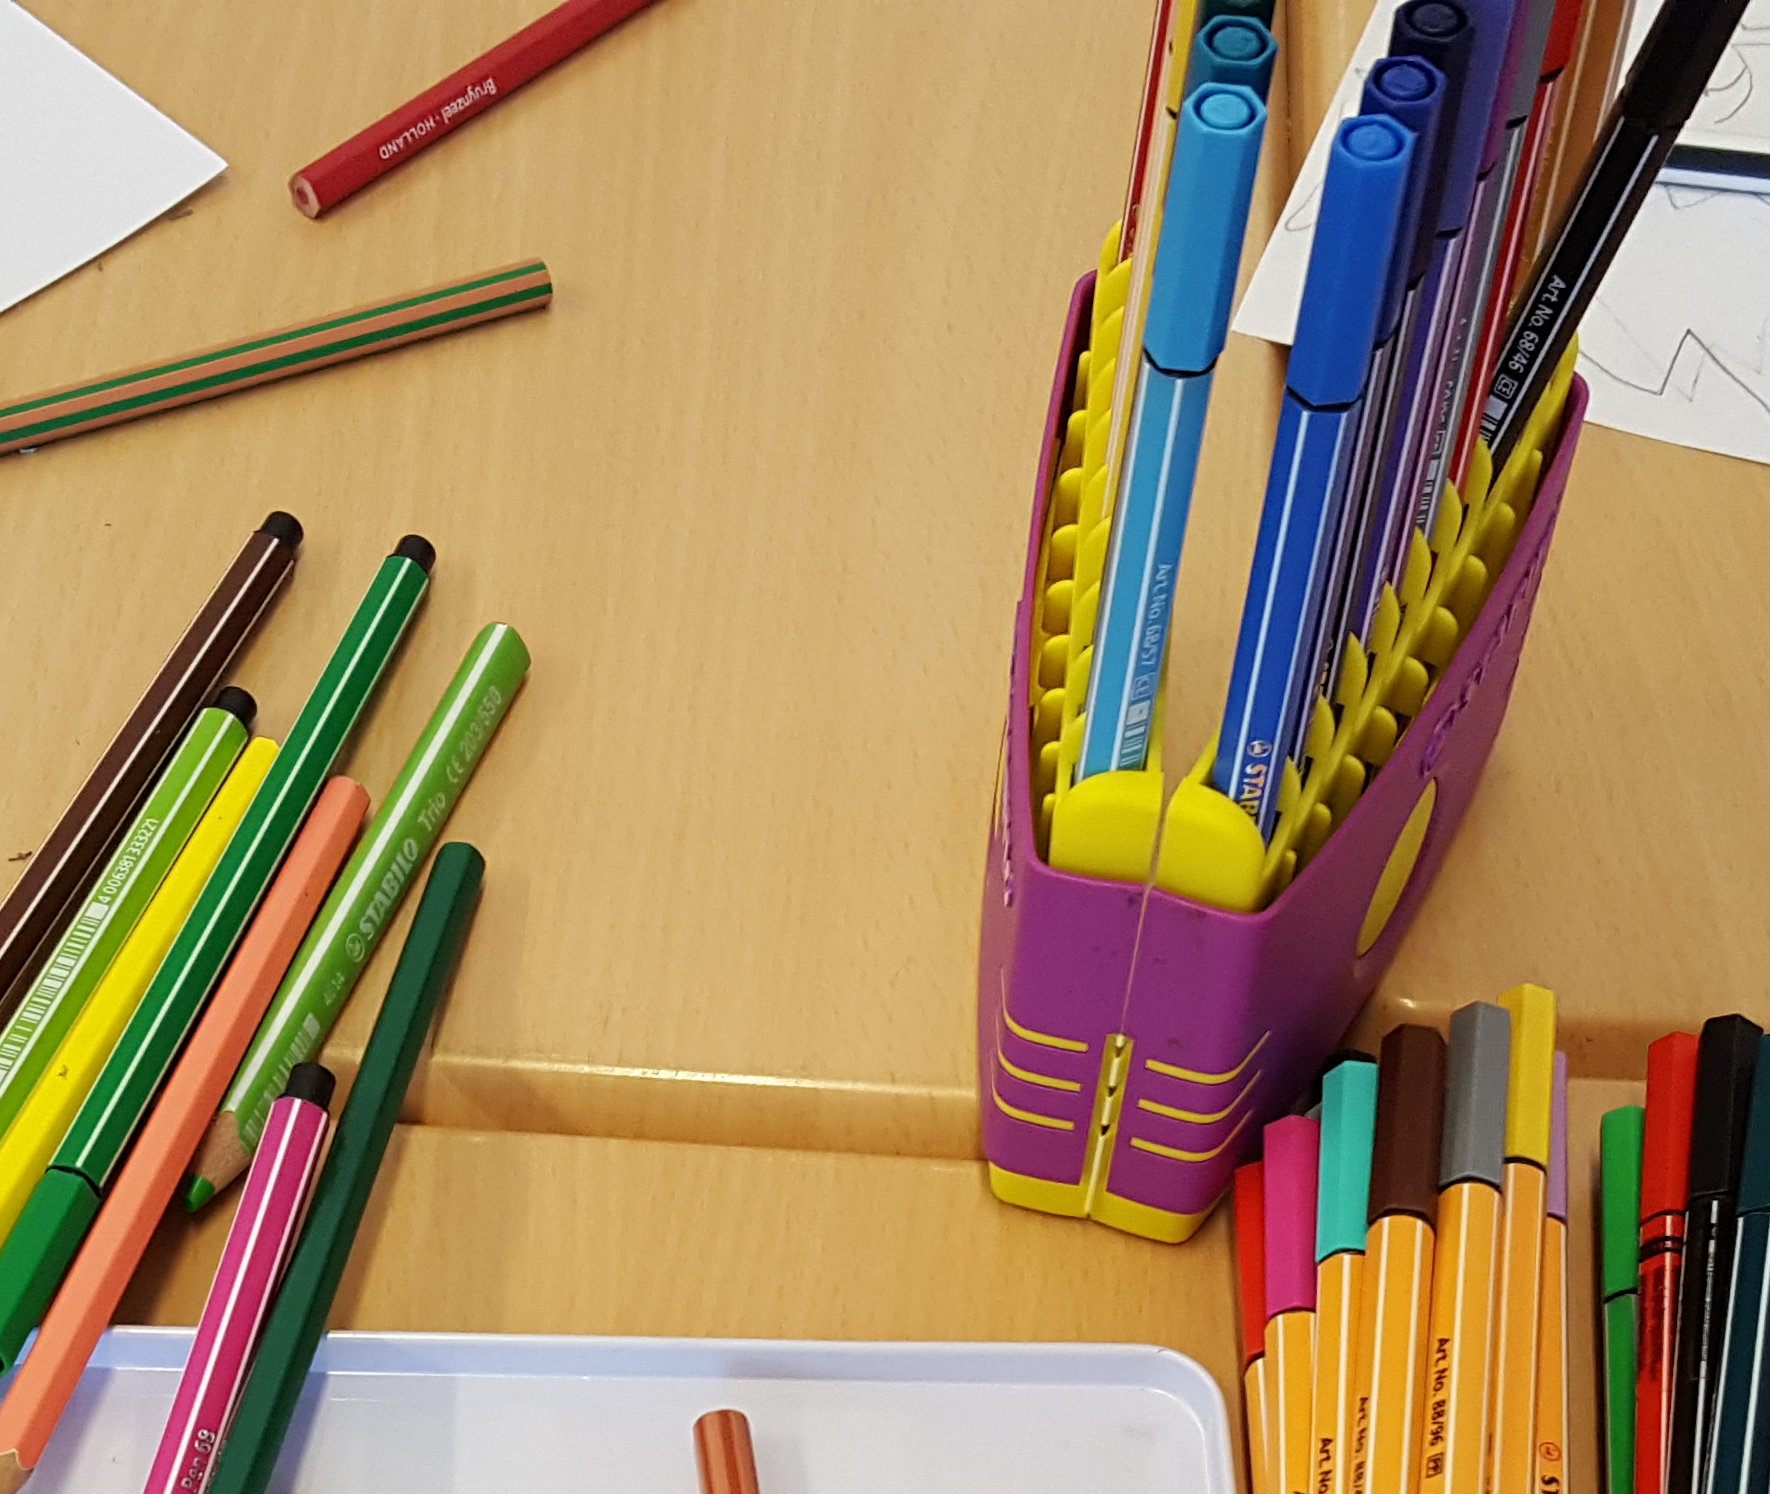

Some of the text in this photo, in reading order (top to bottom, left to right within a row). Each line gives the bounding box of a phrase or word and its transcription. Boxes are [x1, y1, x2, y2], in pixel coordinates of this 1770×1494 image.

[379, 77, 497, 160] Bruynzeel HOLLAND
[1527, 302, 1553, 332] No.
[1506, 328, 1538, 373] 68/46
[358, 838, 420, 941] STABILO
[417, 791, 447, 831] Trio
[180, 1456, 205, 1493] Pen
[194, 1428, 217, 1454] 68
